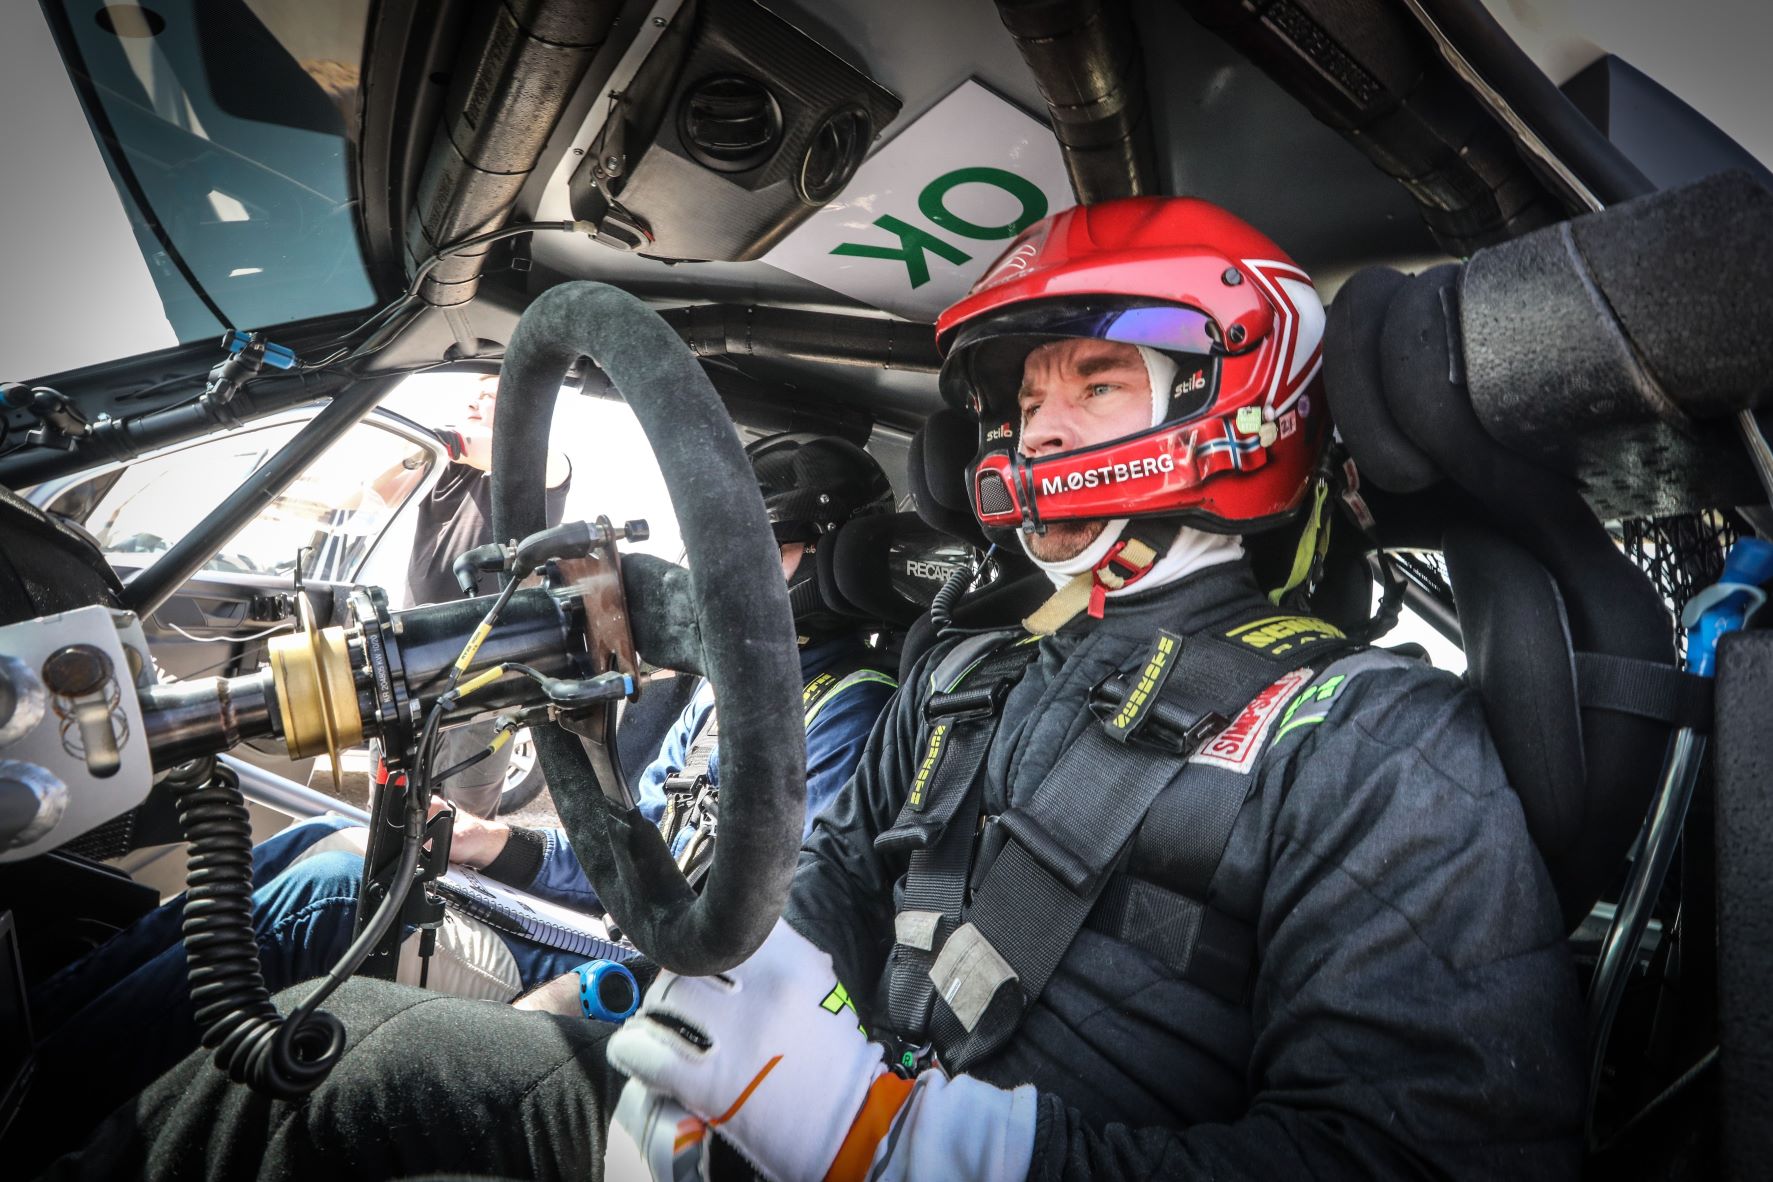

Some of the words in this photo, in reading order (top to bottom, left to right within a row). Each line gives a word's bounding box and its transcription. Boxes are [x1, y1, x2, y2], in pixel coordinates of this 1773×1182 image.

[830, 166, 1048, 290] OK
[1174, 372, 1206, 399] stilo
[986, 424, 1013, 442] stilo
[1041, 453, 1175, 496] M.ØSTBERG
[1112, 636, 1174, 729] SCHROTH
[910, 725, 946, 805] SCHROTH
